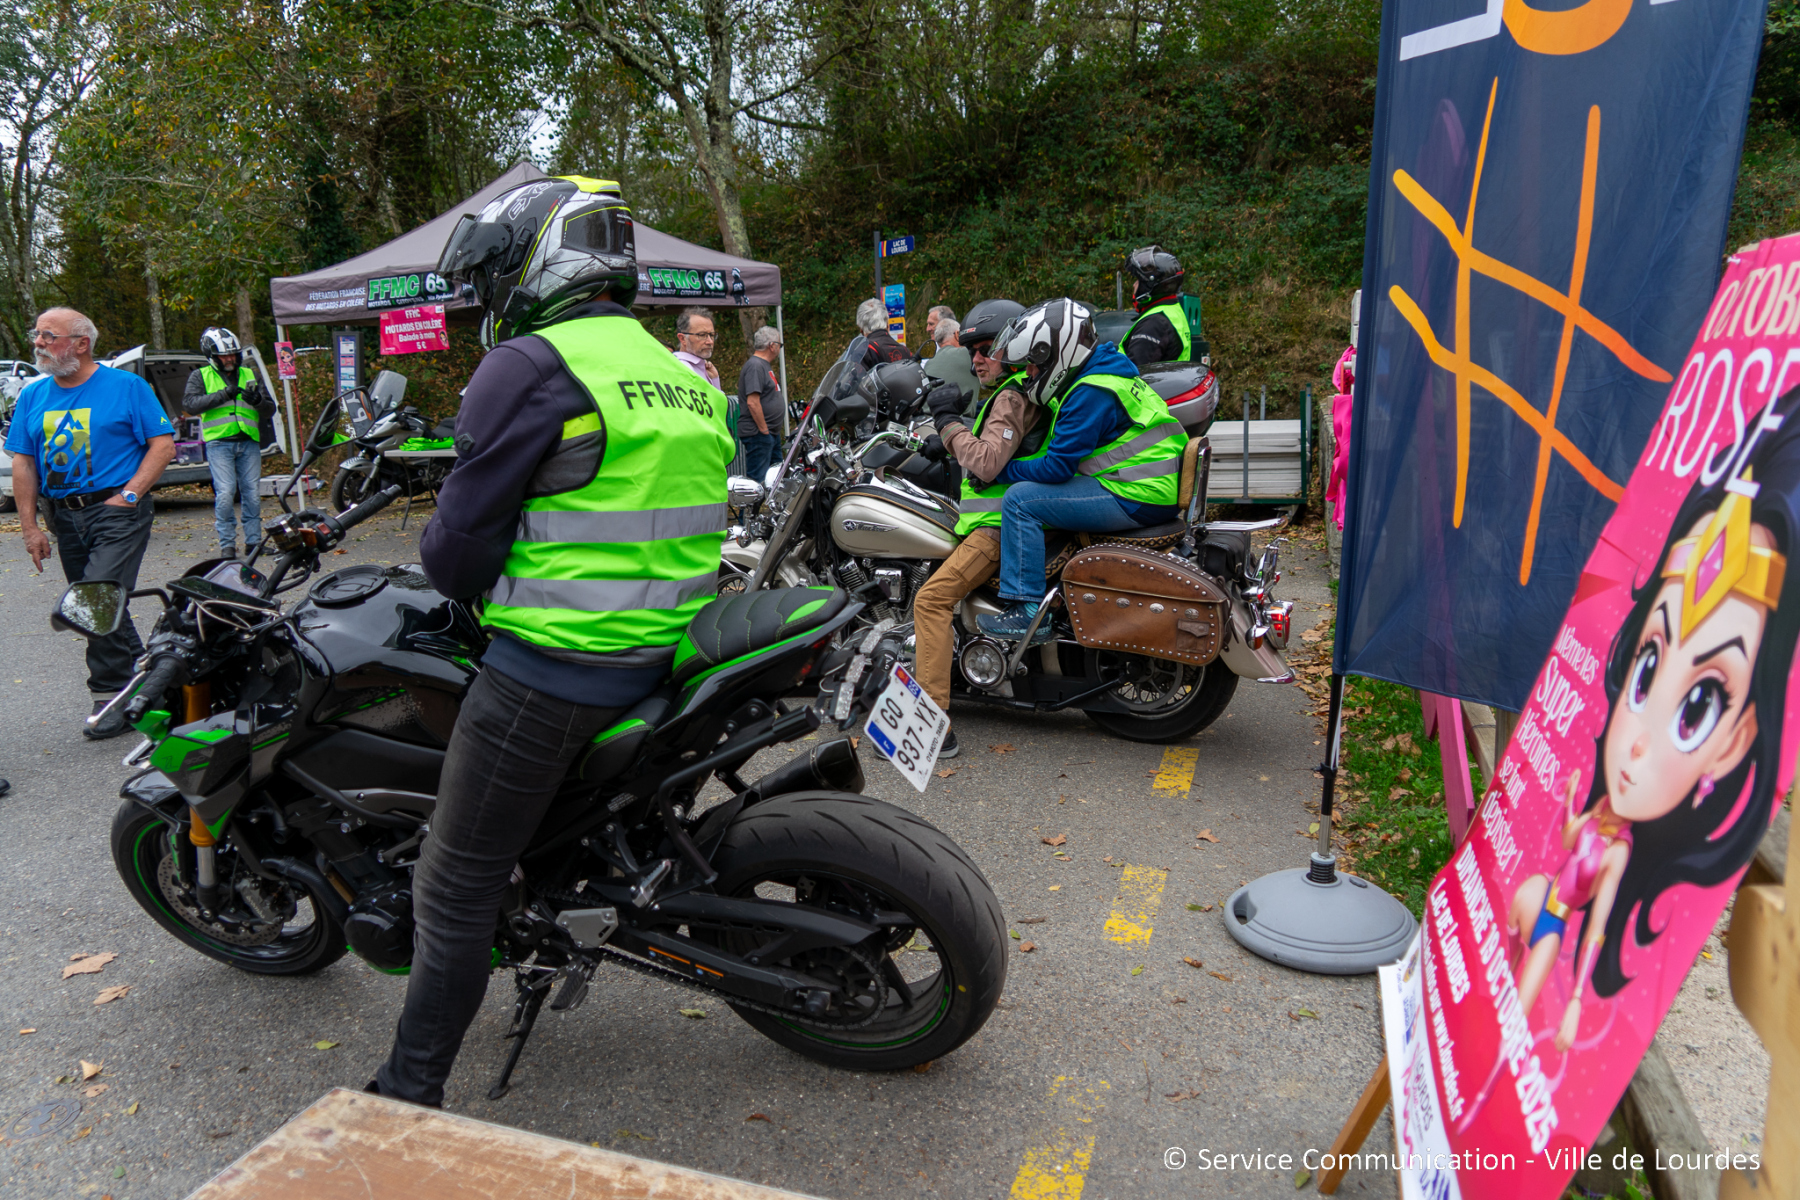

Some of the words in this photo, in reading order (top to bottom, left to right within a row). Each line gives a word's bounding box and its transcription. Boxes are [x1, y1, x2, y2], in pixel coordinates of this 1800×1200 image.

[891, 245, 908, 254] LOURDES
[892, 239, 901, 248] LAC
[368, 274, 419, 300] FFMC
[425, 272, 449, 293] 65
[649, 268, 701, 290] FFMC
[704, 271, 724, 290] 65
[385, 322, 415, 334] MOTARDS
[414, 321, 423, 331] EN
[423, 318, 443, 330] COLÈRE
[405, 309, 421, 319] FFMC
[617, 381, 713, 418] FFMC65
[1645, 347, 1800, 499] ROSE
[1555, 624, 1586, 671] Même
[1579, 647, 1599, 685] les
[1537, 656, 1585, 738] Super
[1499, 755, 1513, 784] se
[1505, 763, 1528, 810] font
[1482, 790, 1519, 872] dépister
[1455, 841, 1494, 944] DIMANCHE
[1479, 922, 1500, 965] 19
[1425, 954, 1438, 994] infos
[1485, 946, 1534, 1077] OCTOBRE
[1515, 1055, 1559, 1154] 2025
